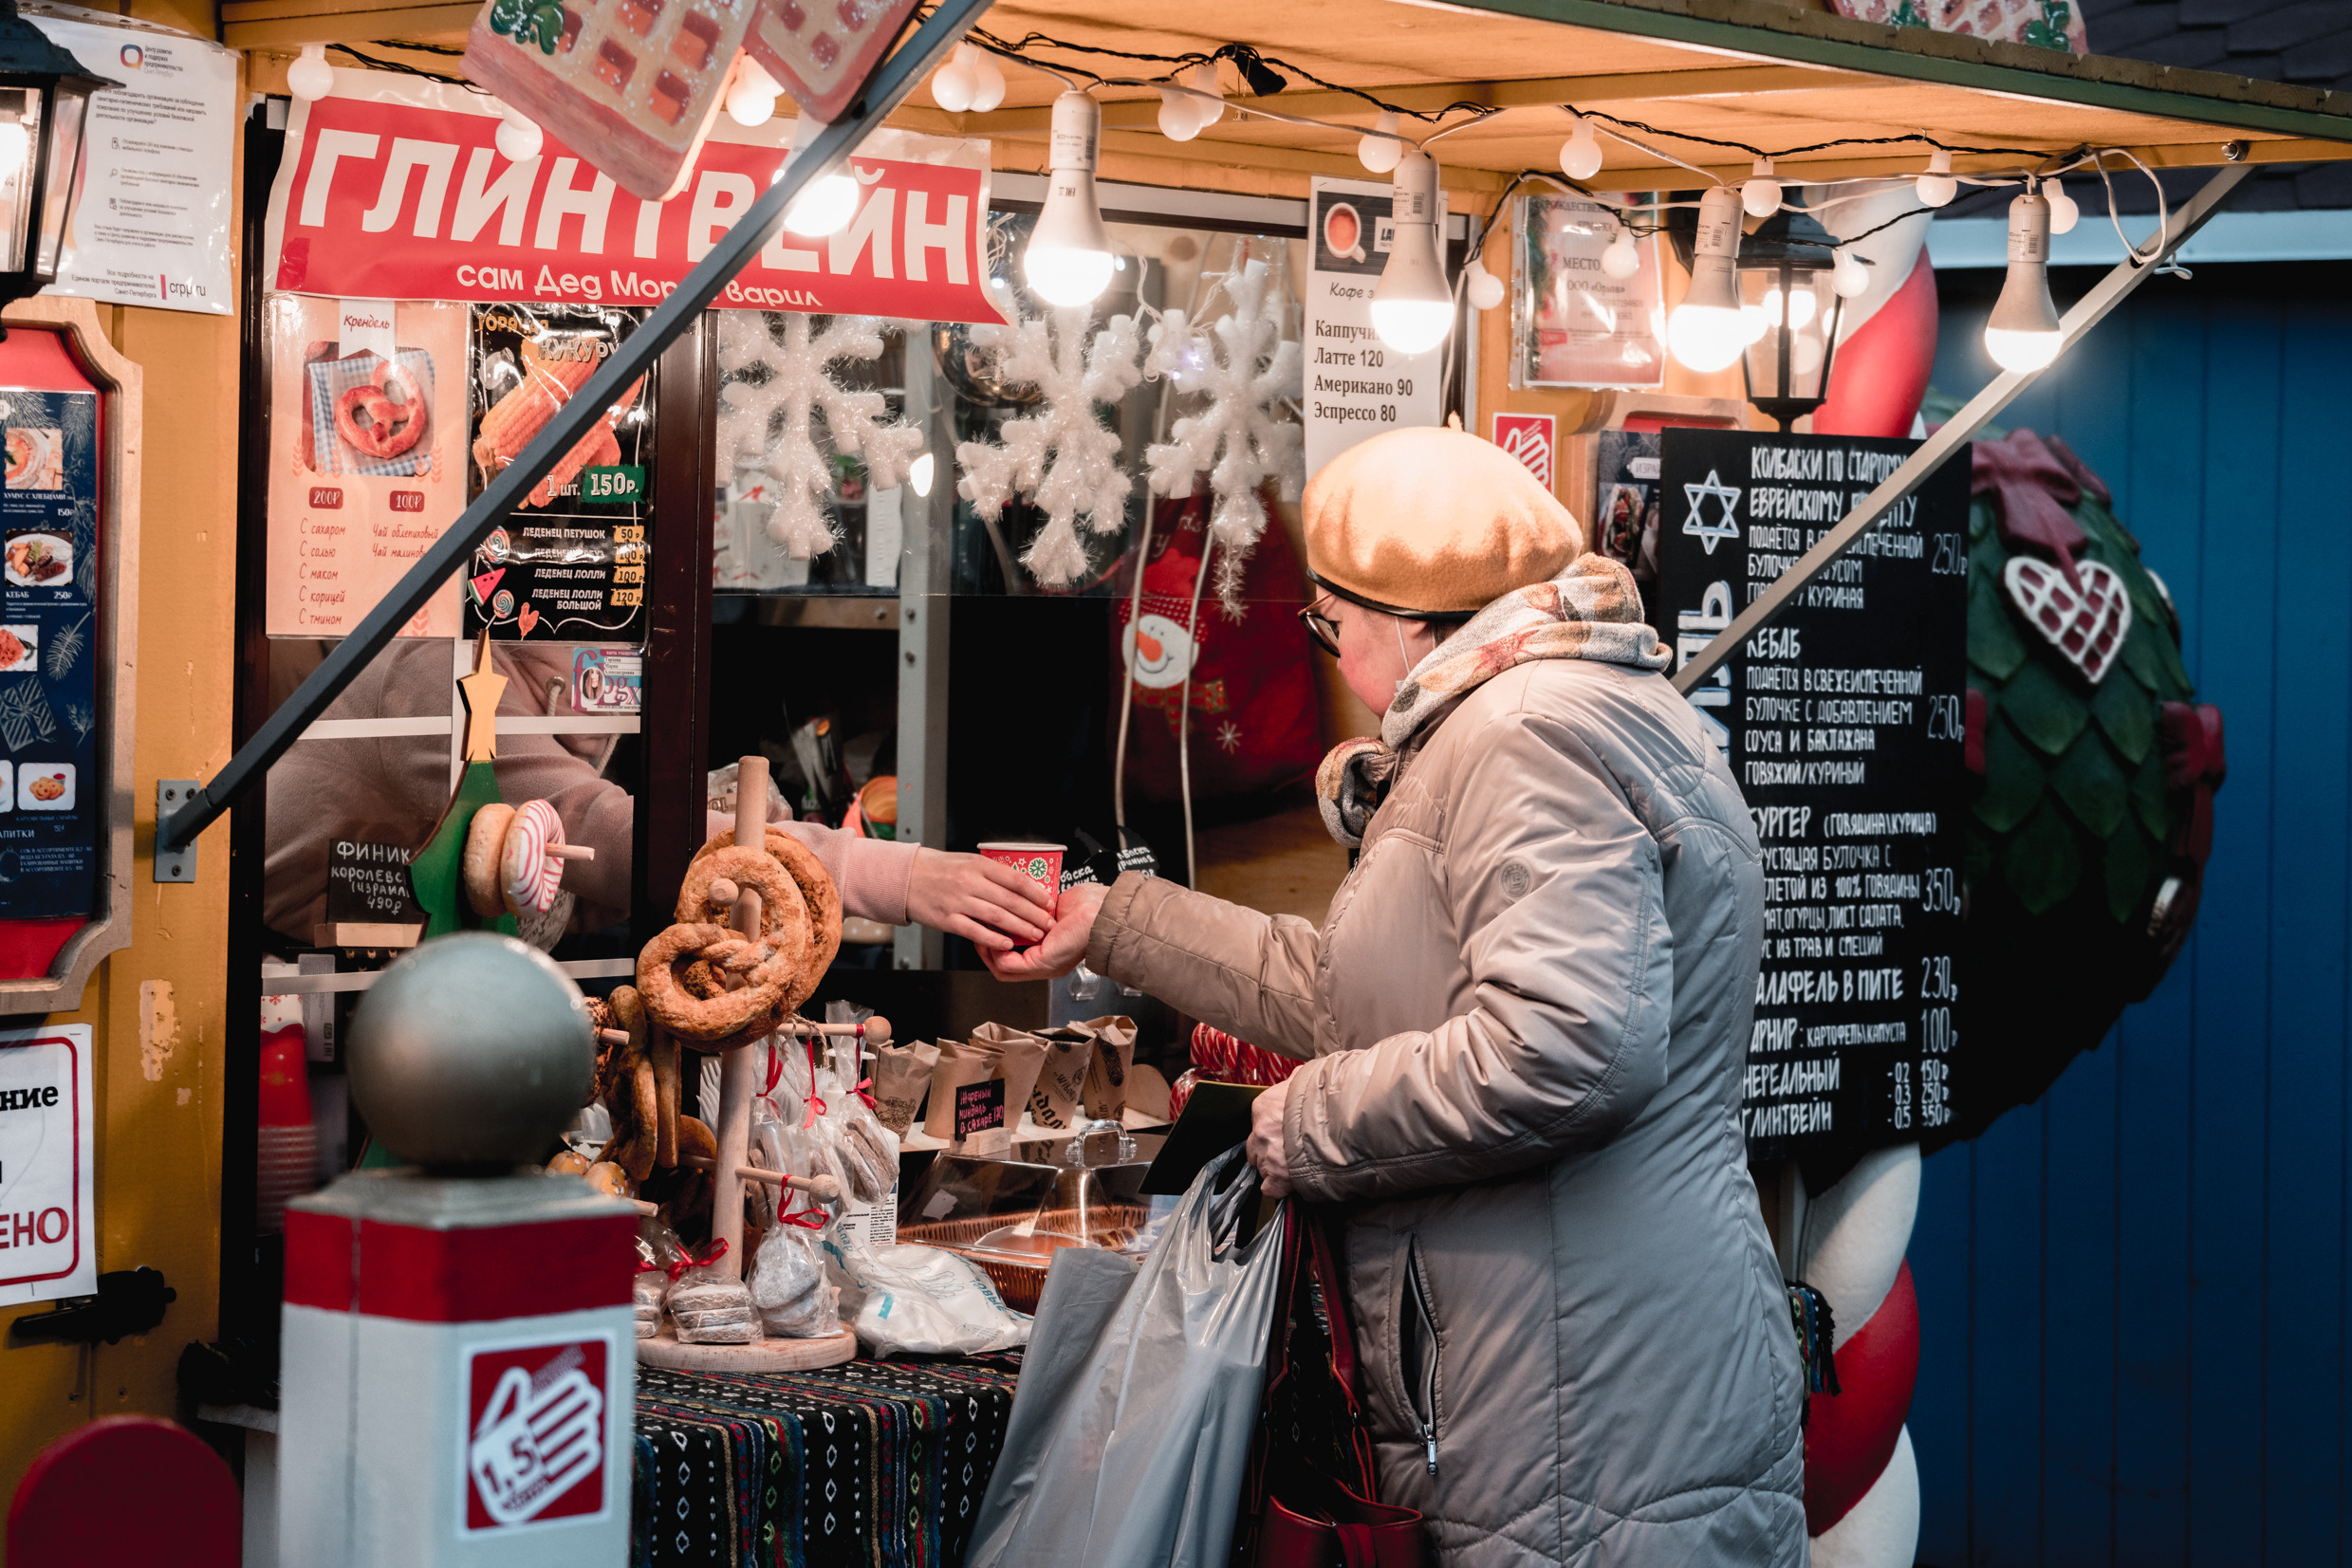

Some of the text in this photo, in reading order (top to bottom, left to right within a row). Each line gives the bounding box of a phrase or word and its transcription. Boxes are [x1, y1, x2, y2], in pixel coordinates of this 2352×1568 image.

[1563, 256, 1601, 271] МЕСТО
[456, 265, 524, 290] сам
[533, 265, 603, 301] Дед
[725, 283, 824, 307] варил
[1329, 282, 1364, 301] Кофе
[343, 314, 391, 332] Крендель
[1314, 347, 1384, 368] Латте 120
[1314, 374, 1413, 397] Американо 90
[1314, 401, 1397, 422] Эспрессо 80
[1750, 446, 1823, 482] КОЛБАСКИ
[1826, 450, 1843, 482] ПО
[546, 474, 558, 498] 1
[1749, 484, 1844, 523] ЕВРЕЙСКОМУ
[300, 517, 346, 539] С сахаром
[373, 522, 389, 539] Чай
[522, 526, 563, 539] ЛЕДЕНЕЦ
[564, 527, 606, 540] ПЕТУШОК
[620, 527, 634, 540] 50
[1749, 524, 1800, 551] ПОДАЁТСЯ
[1806, 528, 1815, 551] В
[299, 540, 337, 559] С солью
[372, 542, 389, 558] Чай
[299, 562, 339, 581] С маком
[534, 568, 573, 580] ЛЕДЕНЕЦ
[574, 569, 606, 580] ЛОЛЛИ
[618, 570, 637, 581] 100
[6, 590, 30, 599] КЕБАБ
[299, 584, 346, 610] С корицей
[531, 588, 603, 600] ЛЕДЕНЕЦ ЛОЛЛИ
[556, 600, 602, 611] БОЛЬШОЙ
[616, 592, 634, 602] 120
[1807, 584, 1864, 609] КУРИНАЯ
[299, 607, 342, 625] С тмином
[1746, 664, 1923, 695] ПОДАЁТСЯ В СВЕЖЕИСПЕЧЕННОЙ
[1745, 696, 1801, 723] БУЛОЧКЕ
[1805, 699, 1812, 723] С
[1816, 699, 1913, 725] ДОБАВЛЕНИЕМ
[1745, 728, 1876, 753] СОУСА И БАКЛАЖАНА
[336, 840, 411, 864] ФИНИК
[1823, 844, 1880, 871] БУЛОЧКА
[1884, 844, 1892, 868] С
[331, 866, 403, 883] КОРОЛЕВС
[1810, 876, 1827, 900] ИЗ
[1835, 873, 1862, 898] 100%
[1864, 873, 1920, 899] ГОВЯДИНЫ
[1776, 938, 1791, 959] ИЗ
[1793, 936, 1823, 959] ТРАВ
[1824, 936, 1834, 957] И
[1838, 931, 1883, 957] СПЕЦИЙ
[1755, 969, 1840, 1006] АЛАФЕЛЬ
[1843, 968, 1854, 1003] В
[1858, 968, 1904, 1002] ПИТЕ
[1742, 1050, 1841, 1099] НЕРЕАЛЬНЫЙ
[1741, 1097, 1832, 1138] ГЛИНТВЕЙН
